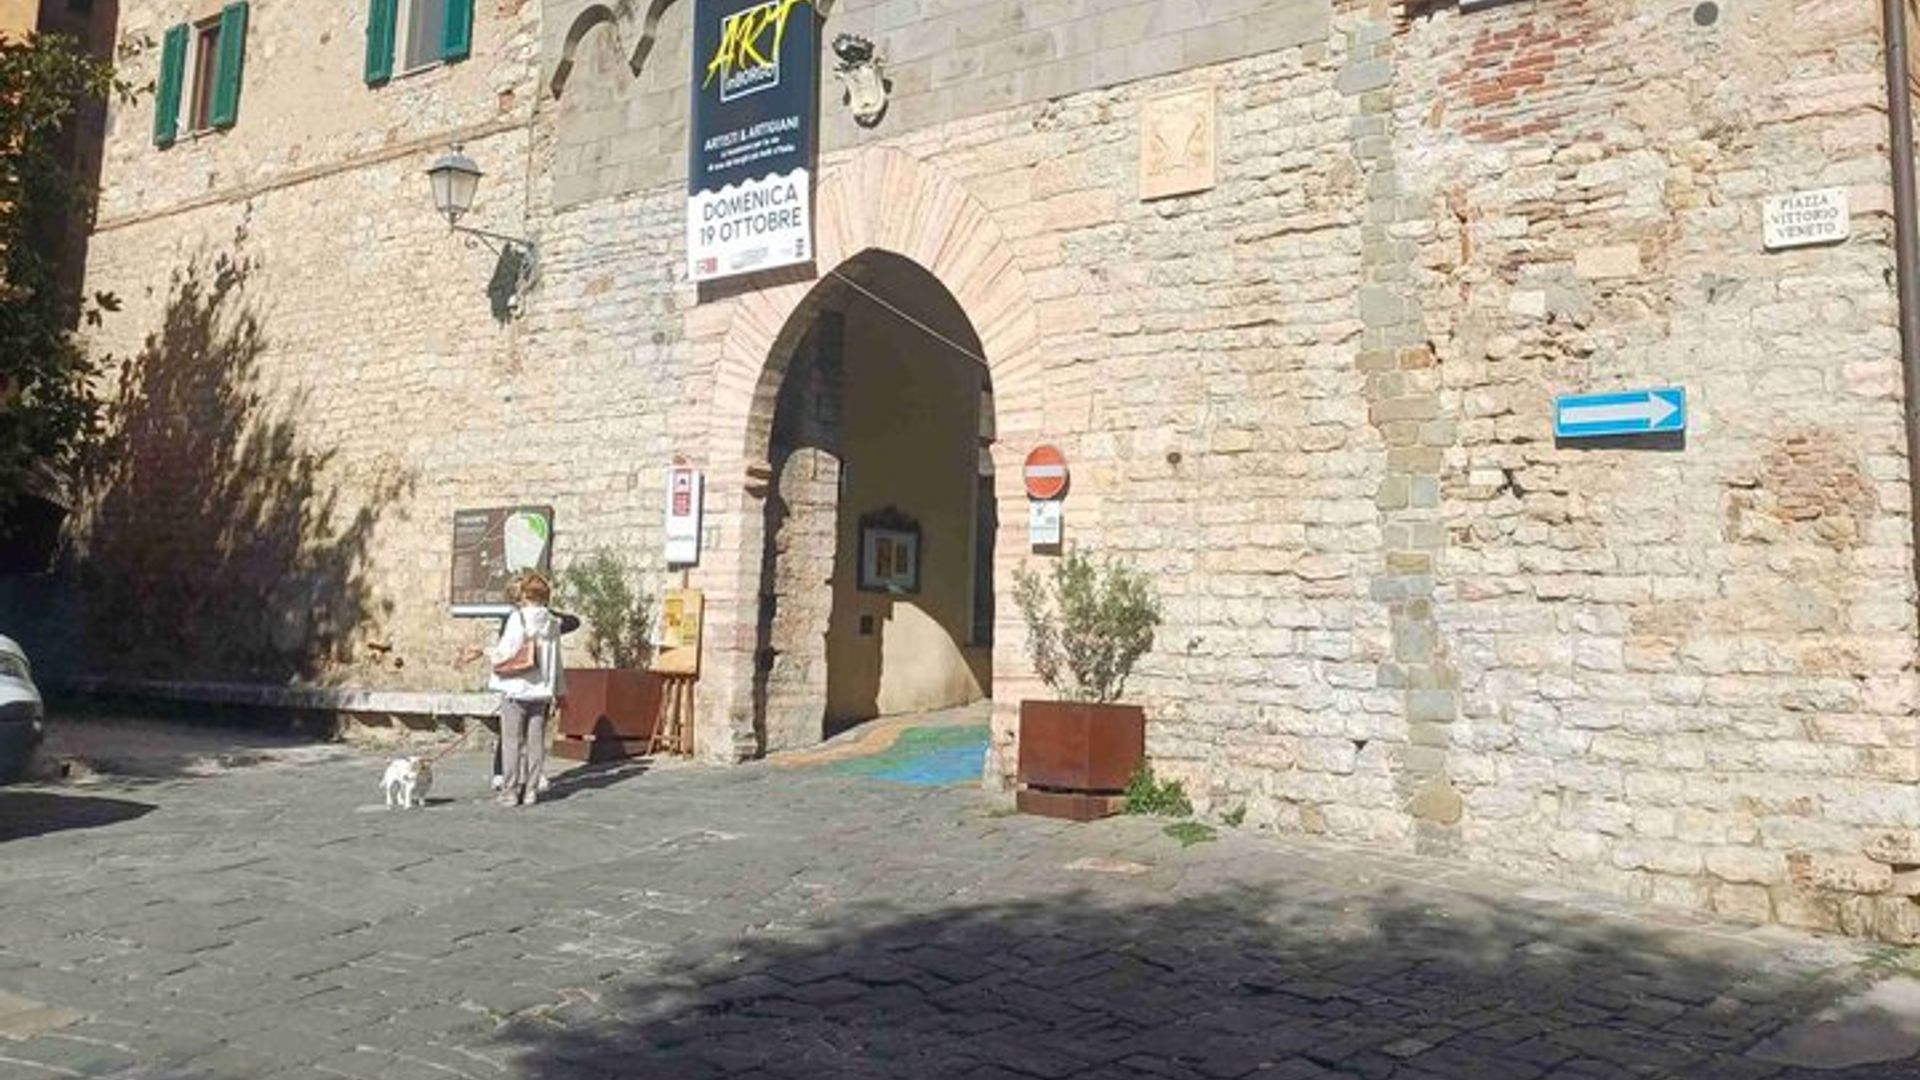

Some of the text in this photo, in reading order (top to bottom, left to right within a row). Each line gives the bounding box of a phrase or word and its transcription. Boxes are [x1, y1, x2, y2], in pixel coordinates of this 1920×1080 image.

[702, 0, 811, 90] ART
[704, 132, 738, 152] ARTISTI
[748, 116, 800, 137] ARTIGIANI
[703, 182, 799, 222] DOMENICA
[1771, 206, 1839, 225] VITTORIO
[1779, 194, 1828, 210] PIAZZA
[699, 206, 803, 247] 19 OTTOBRE
[1776, 222, 1836, 238] VENETO
